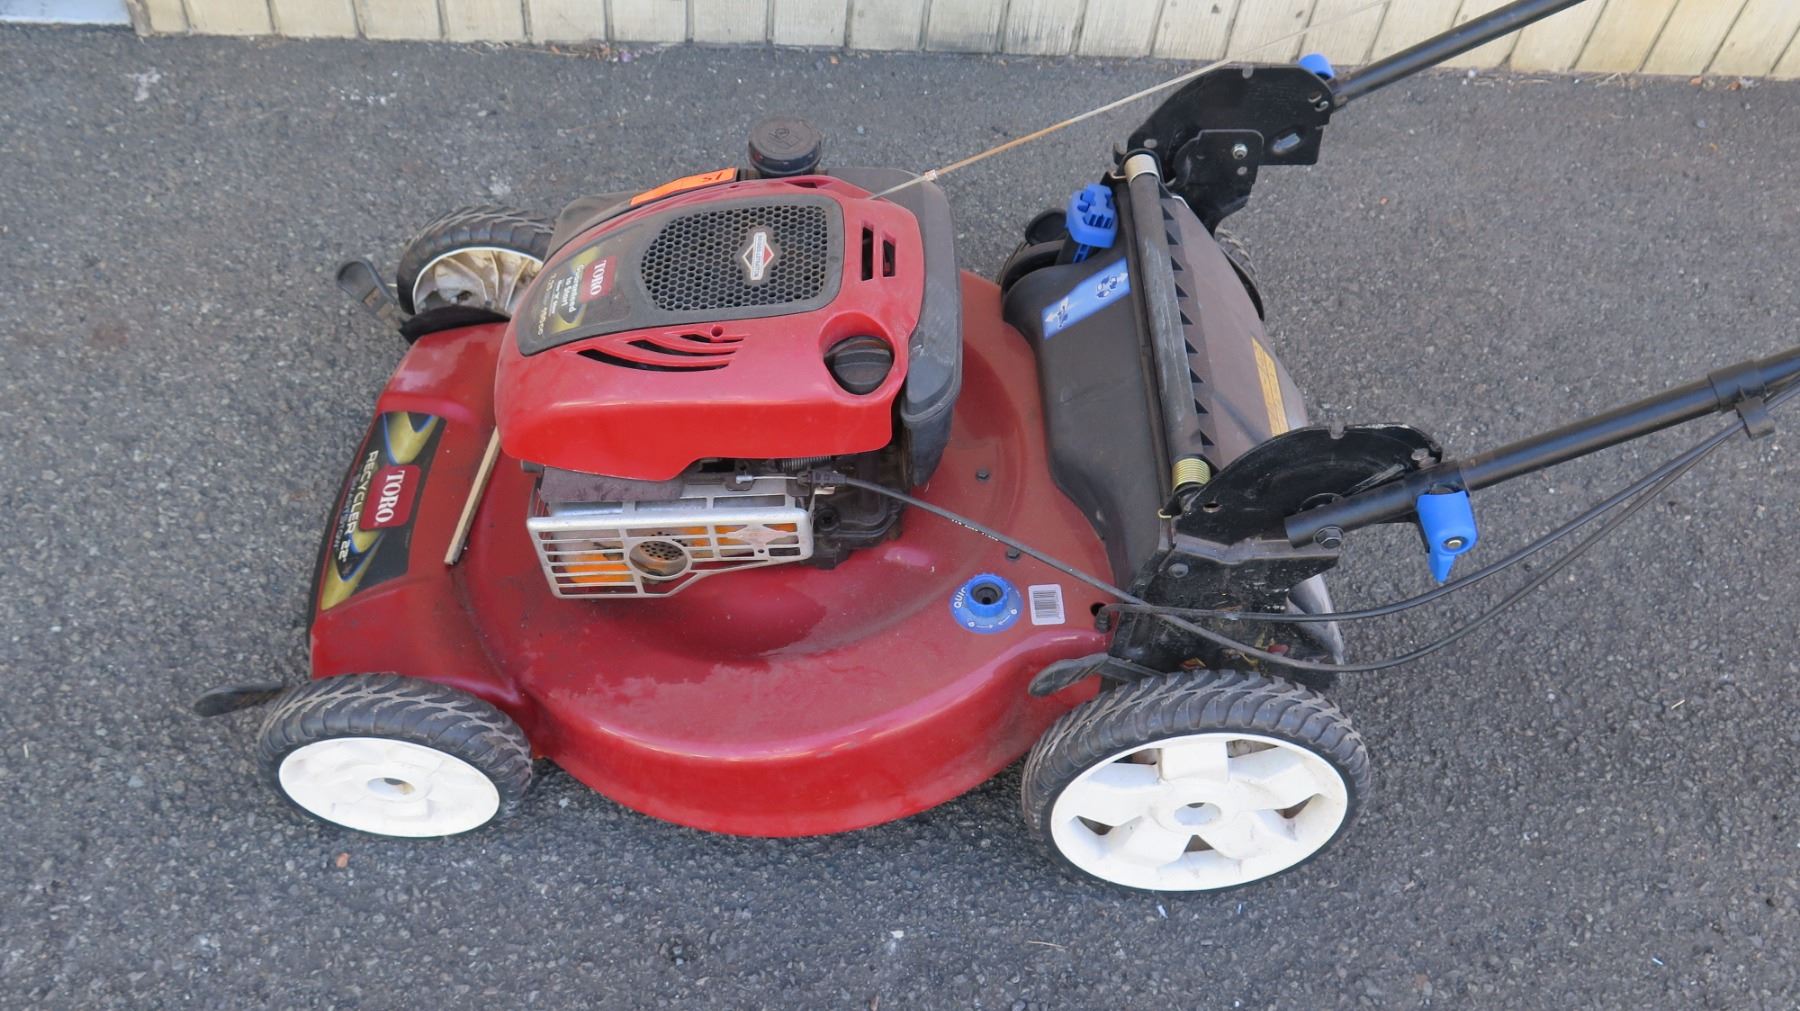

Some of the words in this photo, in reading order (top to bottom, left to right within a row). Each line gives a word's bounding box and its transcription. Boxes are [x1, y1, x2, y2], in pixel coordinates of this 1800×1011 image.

[590, 259, 607, 296] TORO
[344, 450, 379, 535] RECYCLER
[375, 469, 406, 523] TORO
